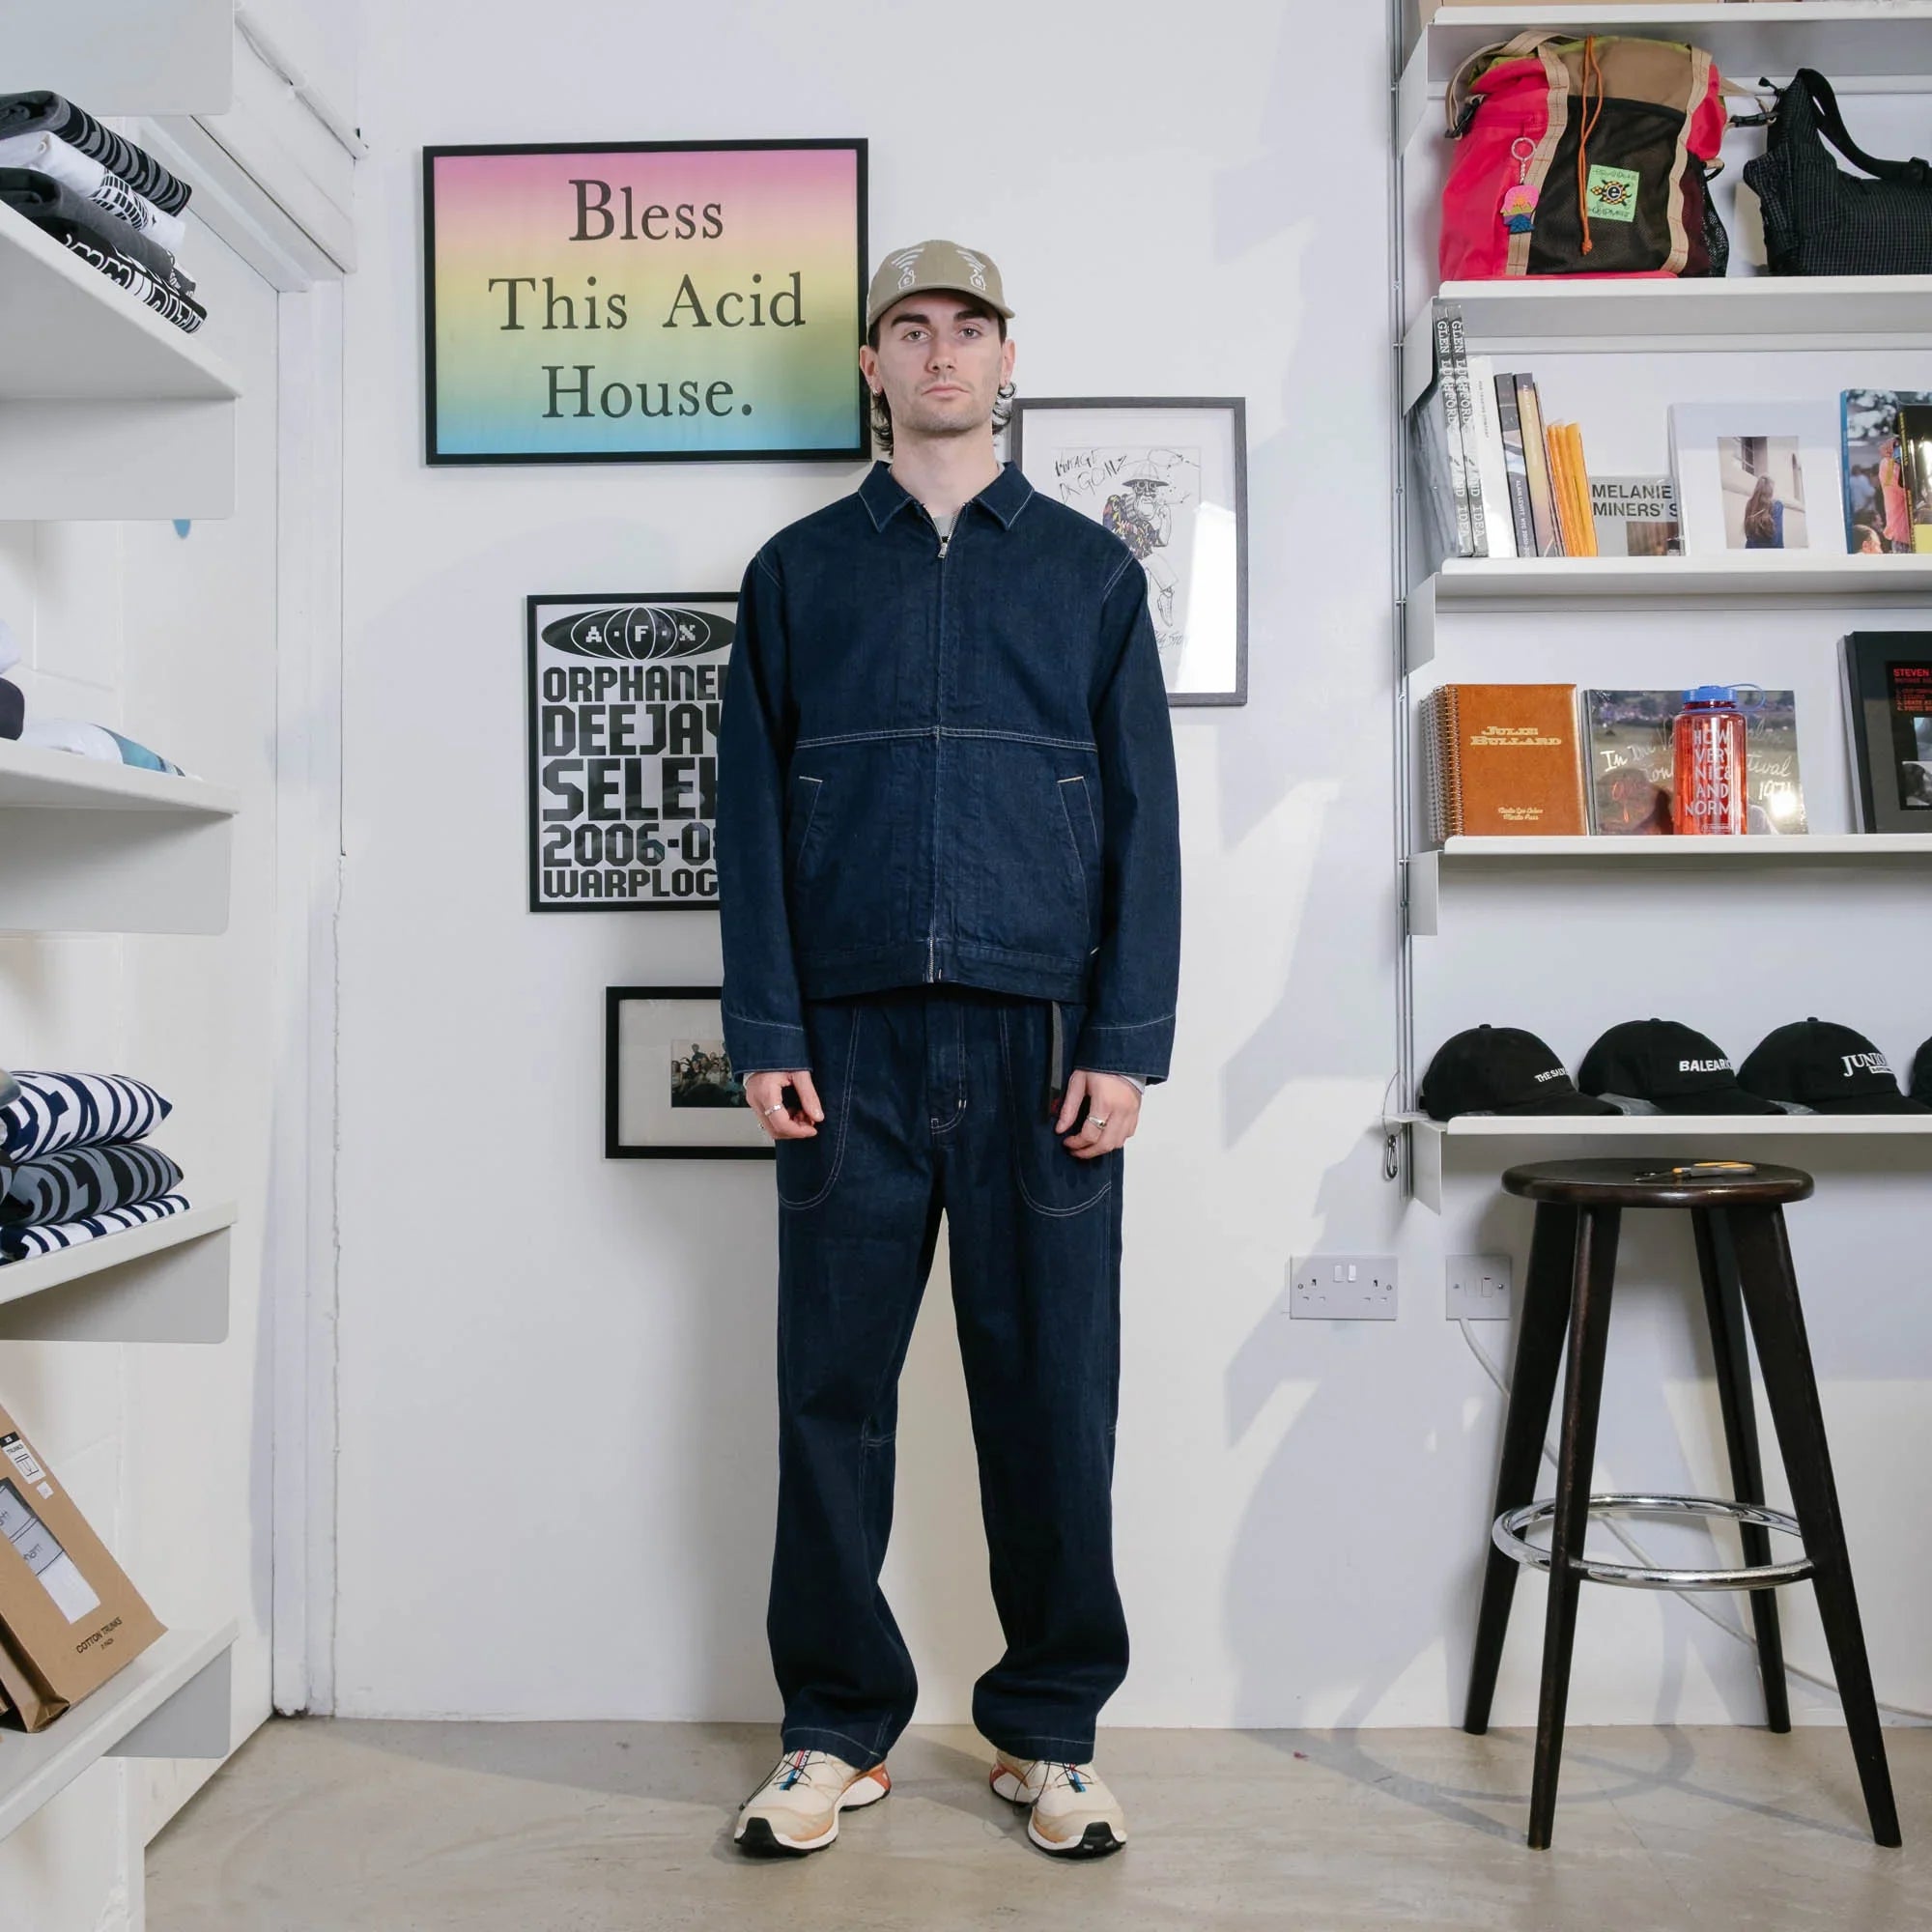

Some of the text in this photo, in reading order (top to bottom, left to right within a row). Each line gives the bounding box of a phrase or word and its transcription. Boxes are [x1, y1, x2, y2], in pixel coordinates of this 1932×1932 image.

[568, 179, 724, 242] Bless
[488, 270, 807, 331] This Acid
[1437, 321, 1450, 354] GLEN
[1452, 320, 1464, 354] GLEN
[541, 364, 753, 418] House.
[1592, 484, 1672, 499] MELANIE
[1593, 502, 1663, 518] MINERS'
[1893, 668, 1929, 677] STEVEN
[1693, 728, 1730, 745] HOW
[1695, 747, 1732, 763] VERY
[1696, 782, 1729, 799] AND
[1685, 800, 1735, 817] NORM
[543, 822, 717, 867] 2006-0
[1534, 1070, 1552, 1083] THE
[76, 1631, 103, 1654] COTTON
